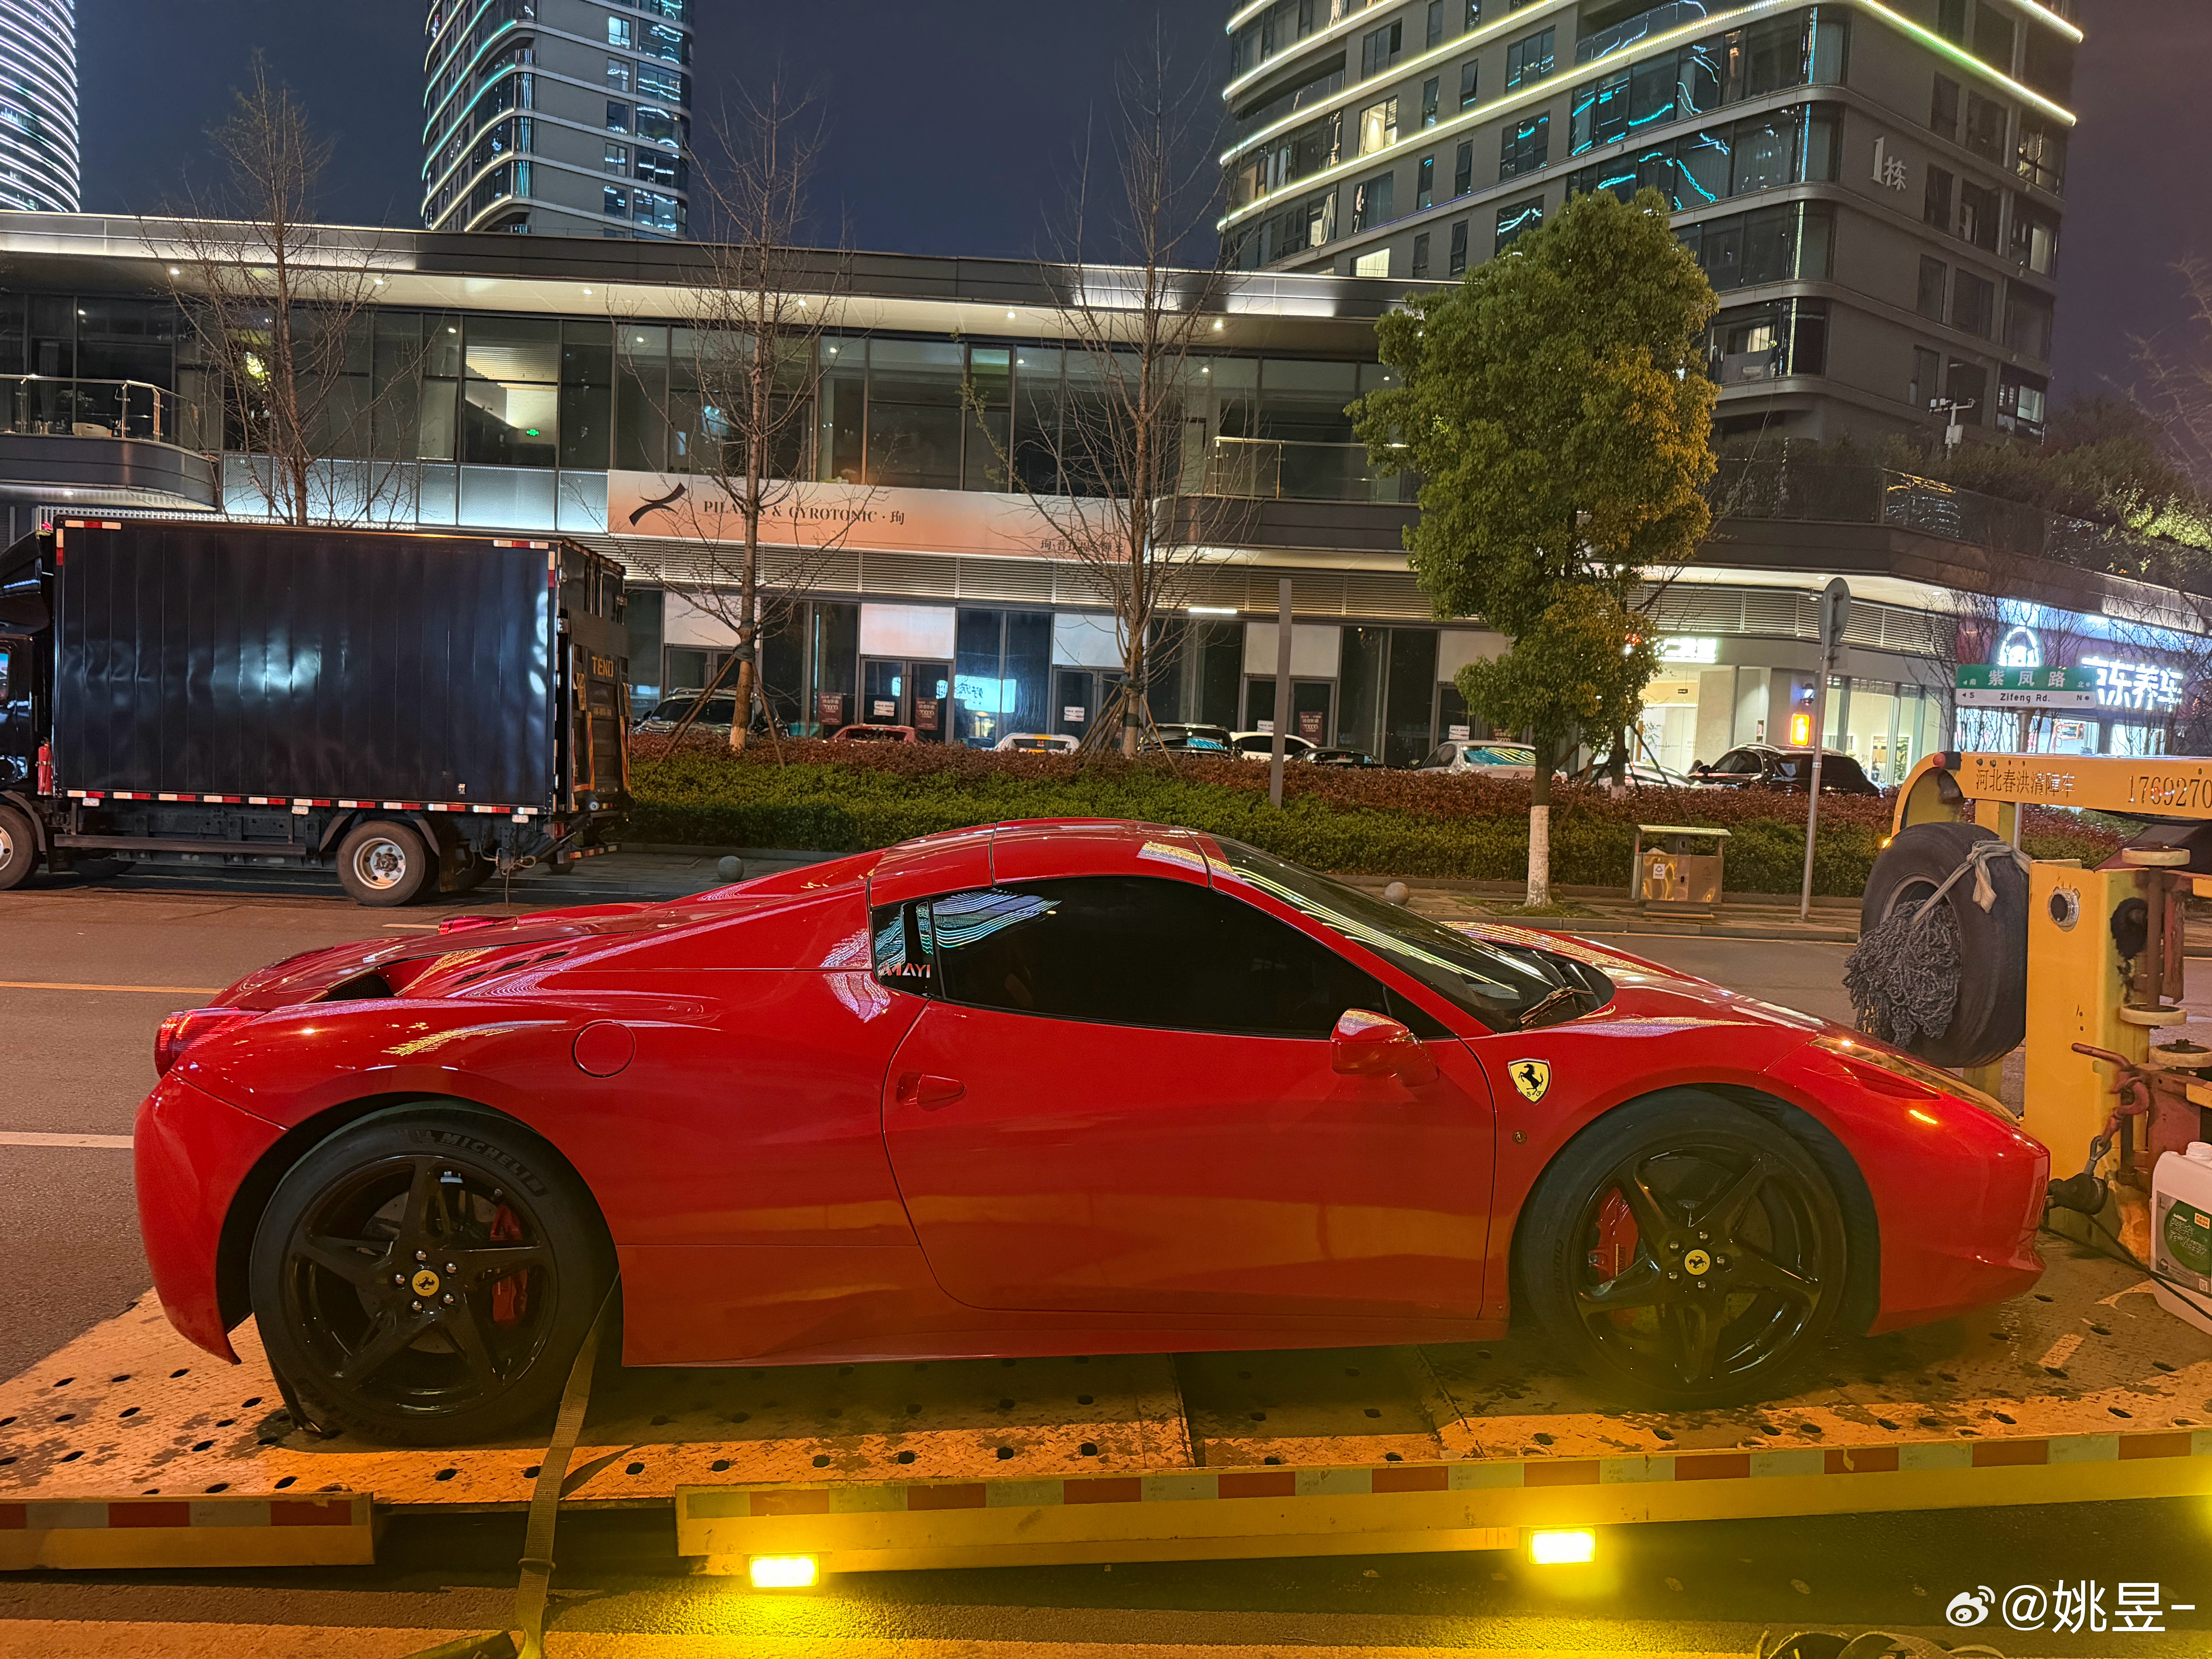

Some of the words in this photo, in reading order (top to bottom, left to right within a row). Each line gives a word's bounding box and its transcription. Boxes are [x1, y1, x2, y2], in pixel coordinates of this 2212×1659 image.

[1870, 137, 1906, 191] 1栋
[1988, 670, 2066, 687] 紫凤路
[2000, 693, 2031, 704] Zifeng
[1976, 769, 2075, 797] 河北春洪清障车
[2128, 775, 2212, 809] 1769270
[440, 1132, 543, 1192] MICHELIN
